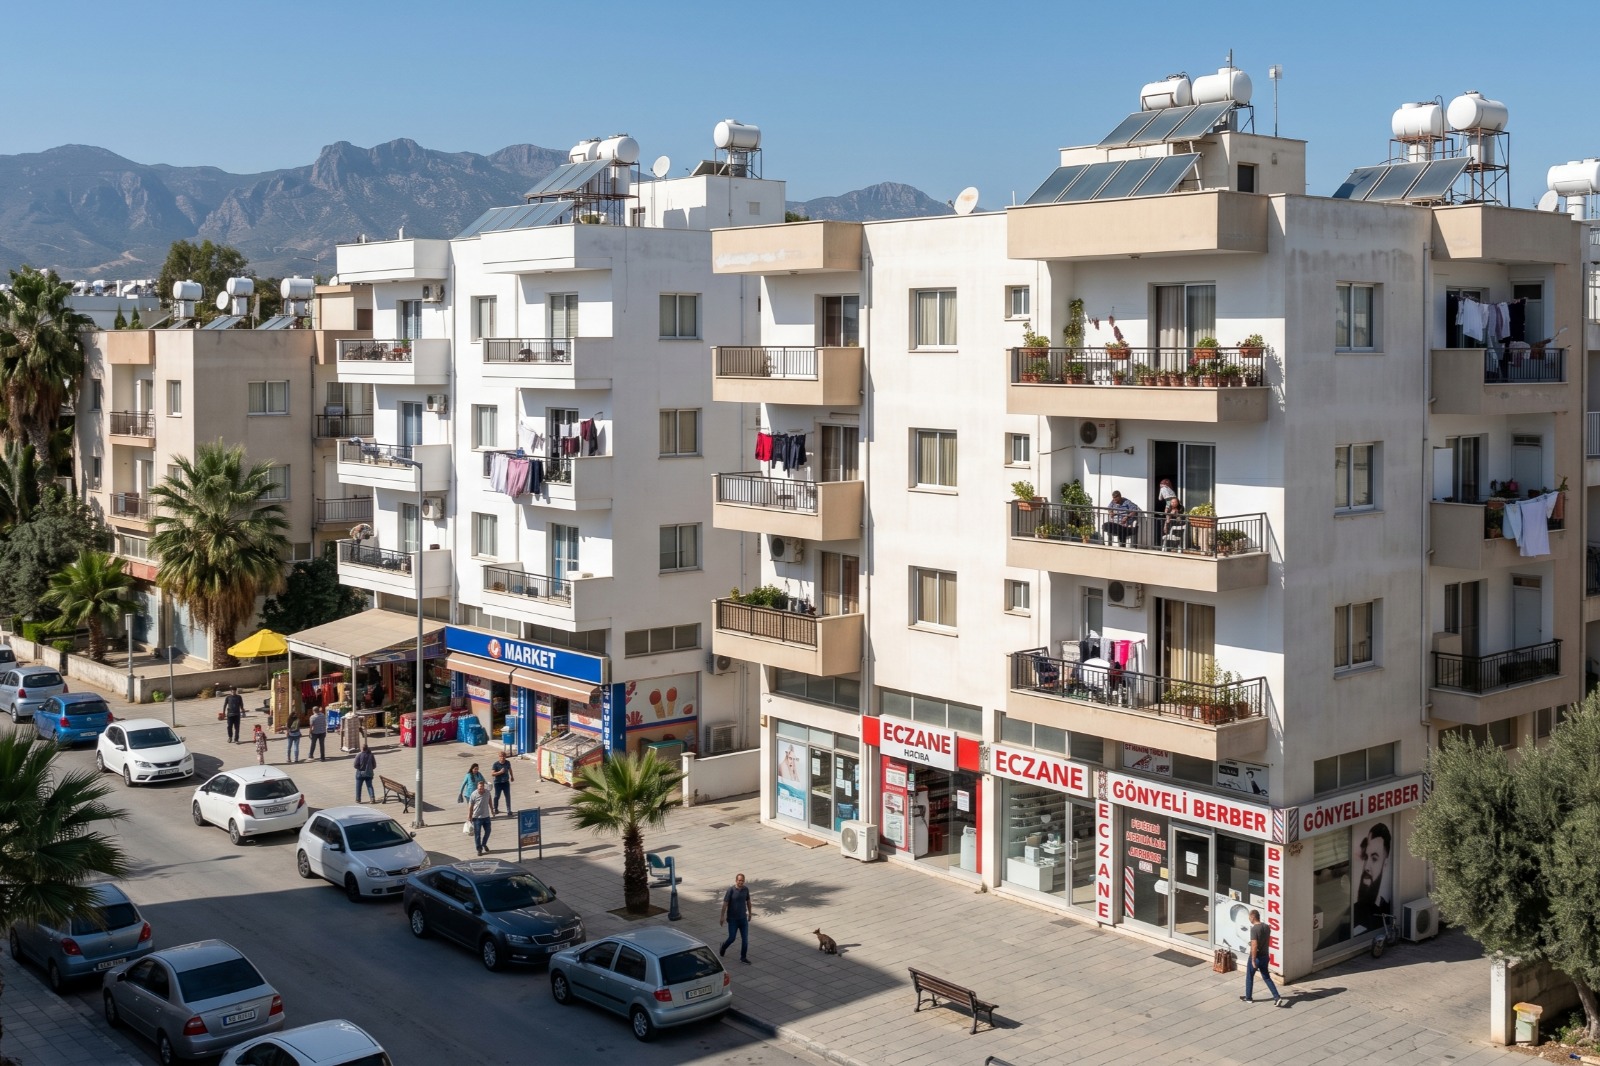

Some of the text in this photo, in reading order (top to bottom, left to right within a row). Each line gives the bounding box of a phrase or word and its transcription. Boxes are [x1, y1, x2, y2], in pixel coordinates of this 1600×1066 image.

[504, 643, 557, 669] MARKET
[883, 722, 951, 755] ECZANE
[995, 750, 1083, 791] ECZANE
[1112, 780, 1188, 815] GÖNYELİ
[1193, 799, 1267, 833] BERBER
[1303, 782, 1420, 832] GÖNYELİ BERBER
[1098, 803, 1111, 919] ECZANE
[1267, 847, 1281, 968] BERRSEL
